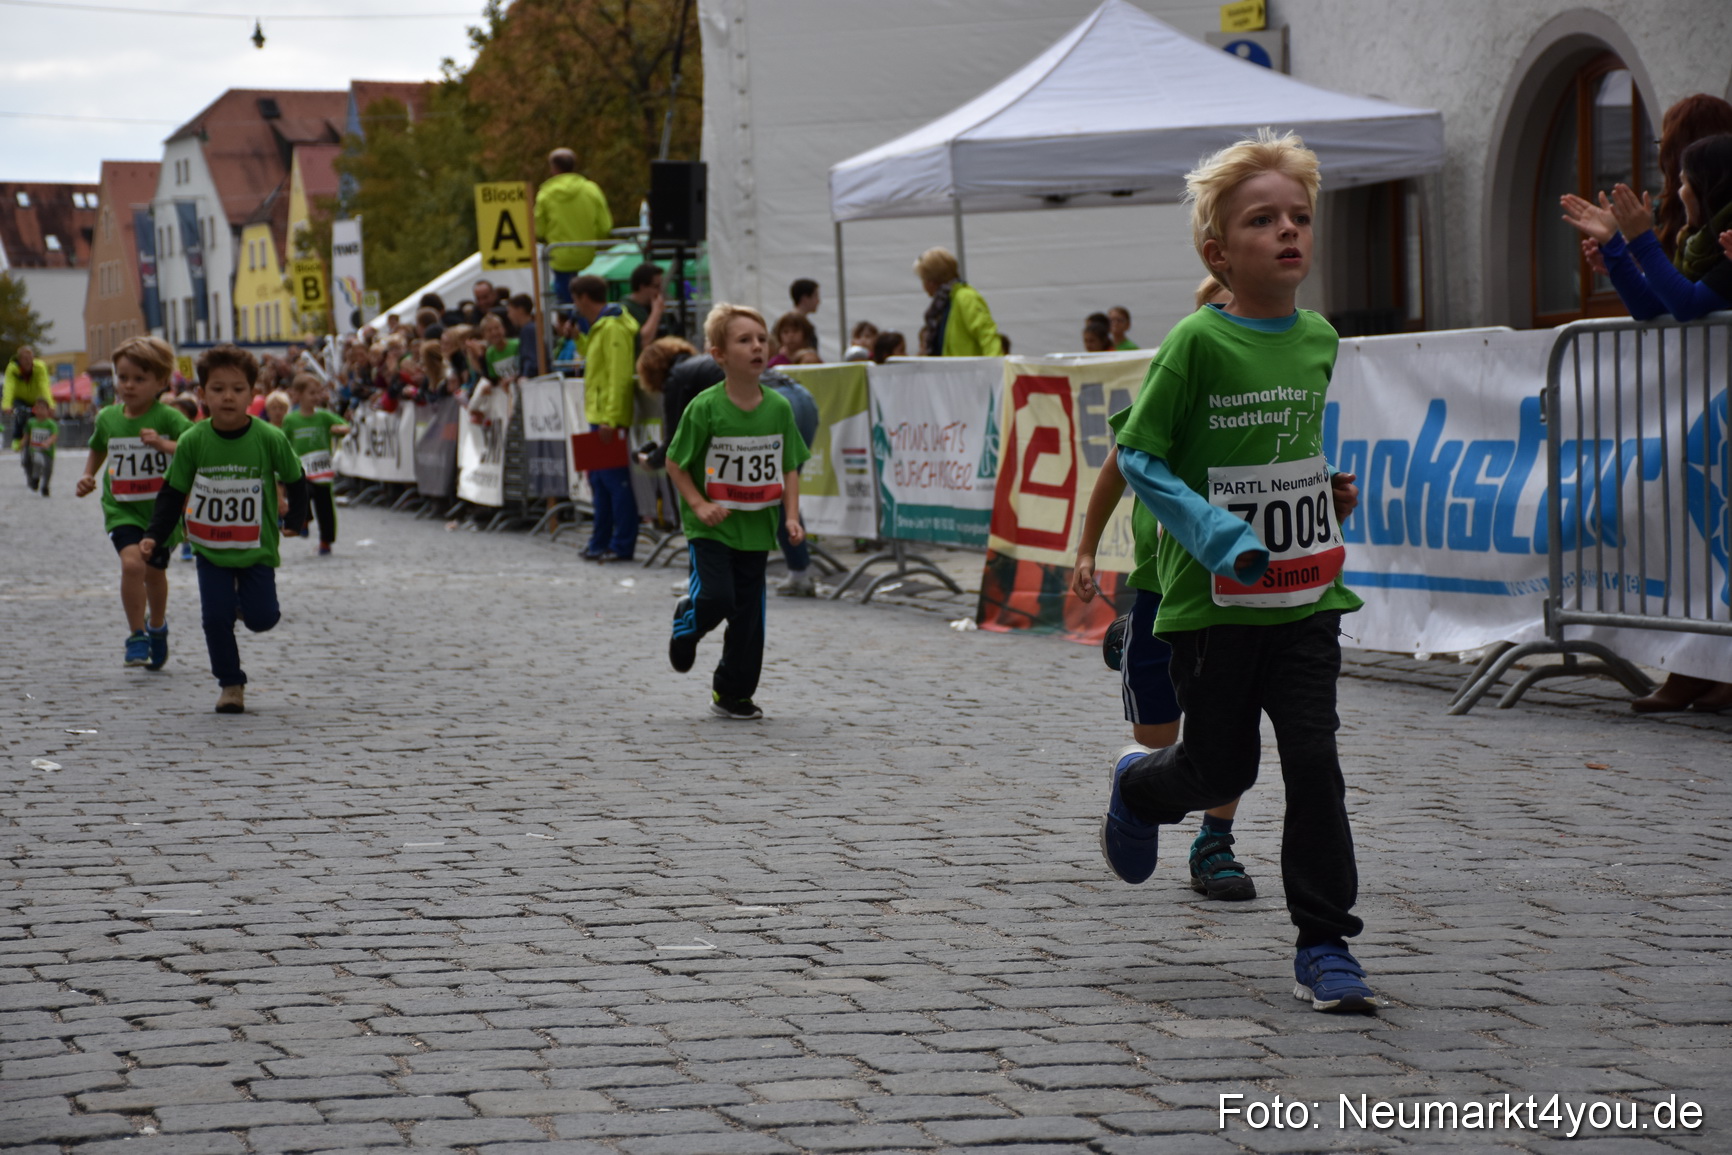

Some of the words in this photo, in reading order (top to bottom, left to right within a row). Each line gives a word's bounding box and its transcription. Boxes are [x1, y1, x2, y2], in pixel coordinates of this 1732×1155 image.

[481, 186, 524, 203] Block
[492, 209, 523, 250] A
[302, 276, 320, 300] B
[1209, 386, 1308, 408] Neumarkter
[1209, 407, 1292, 430] Stadtlauf
[113, 452, 167, 477] 7149
[715, 454, 776, 482] 7135
[727, 488, 764, 499] Vincent
[1213, 480, 1268, 496] PARTL
[195, 493, 255, 523] 7030
[210, 528, 232, 539] Finn
[1262, 564, 1320, 589] Simon
